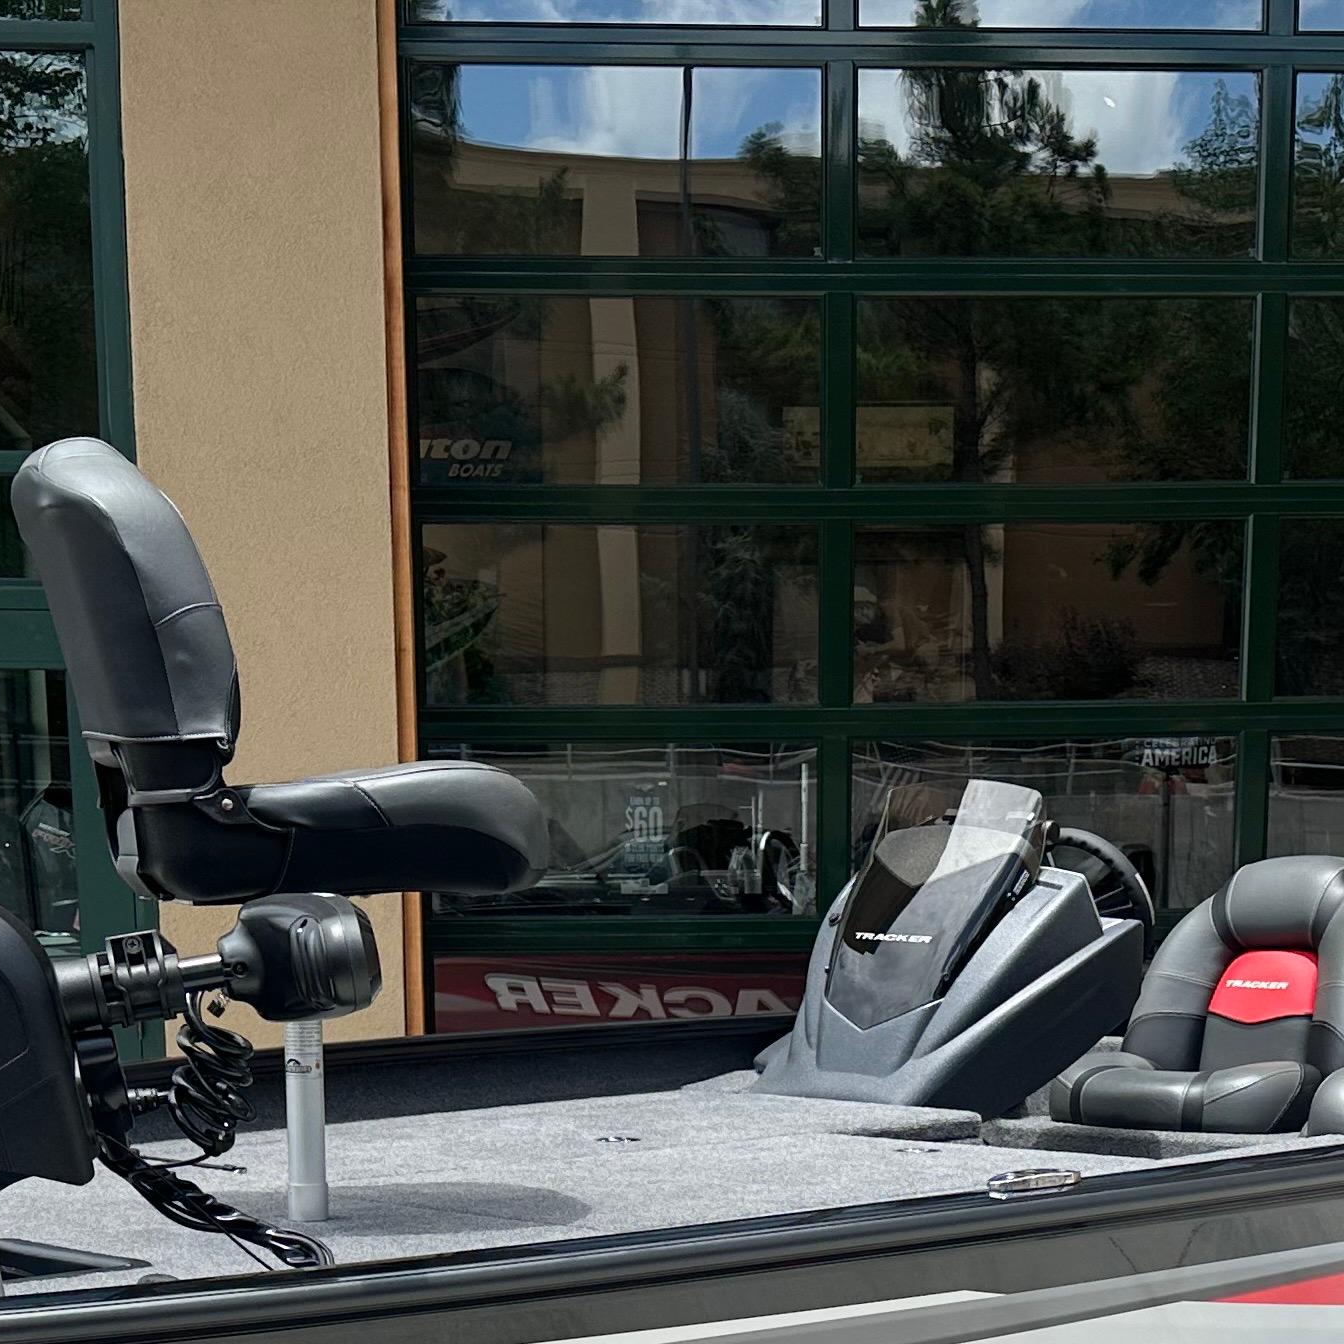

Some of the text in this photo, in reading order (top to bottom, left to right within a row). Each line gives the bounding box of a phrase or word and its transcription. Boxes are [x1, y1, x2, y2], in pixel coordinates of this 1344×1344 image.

[448, 463, 504, 477] BOATS
[1141, 745, 1217, 767] AMERICA
[624, 805, 664, 843] $60
[855, 931, 933, 944] TRACKER
[1225, 979, 1289, 990] TRACKER
